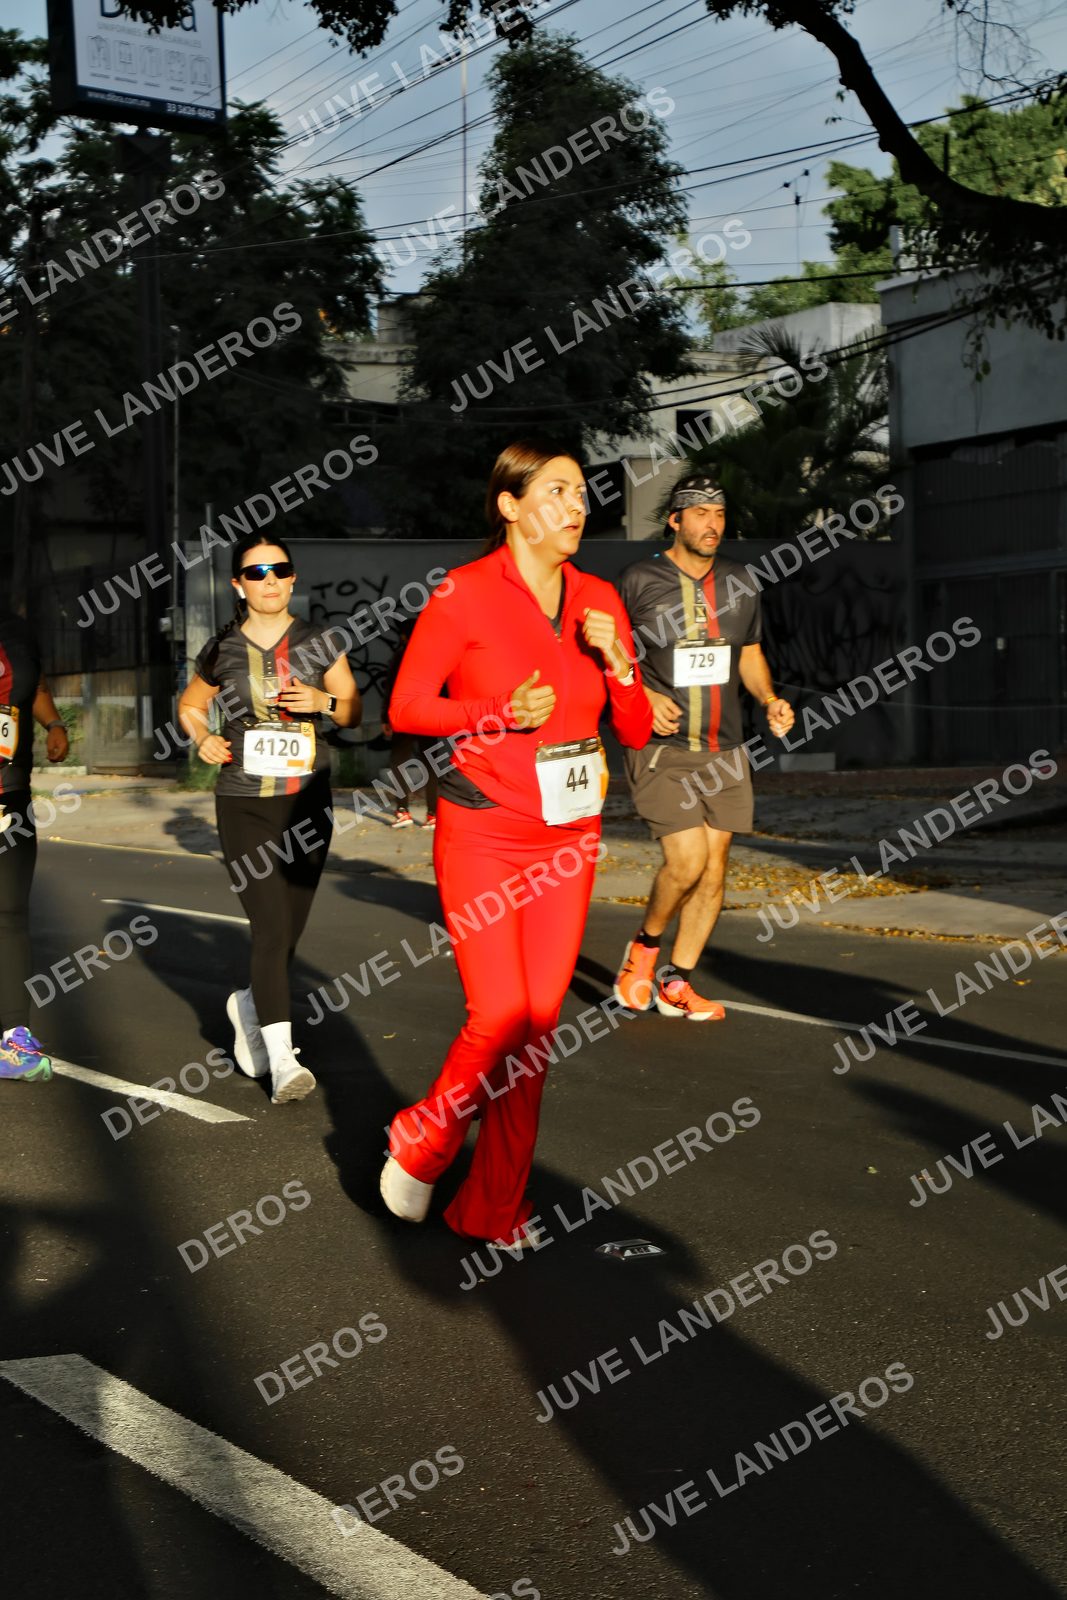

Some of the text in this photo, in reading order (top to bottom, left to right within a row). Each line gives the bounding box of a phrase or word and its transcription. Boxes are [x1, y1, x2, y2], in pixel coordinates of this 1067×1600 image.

[311, 575, 388, 602] TOY
[689, 652, 715, 669] 729
[254, 737, 300, 757] 4120
[566, 765, 588, 792] 44
